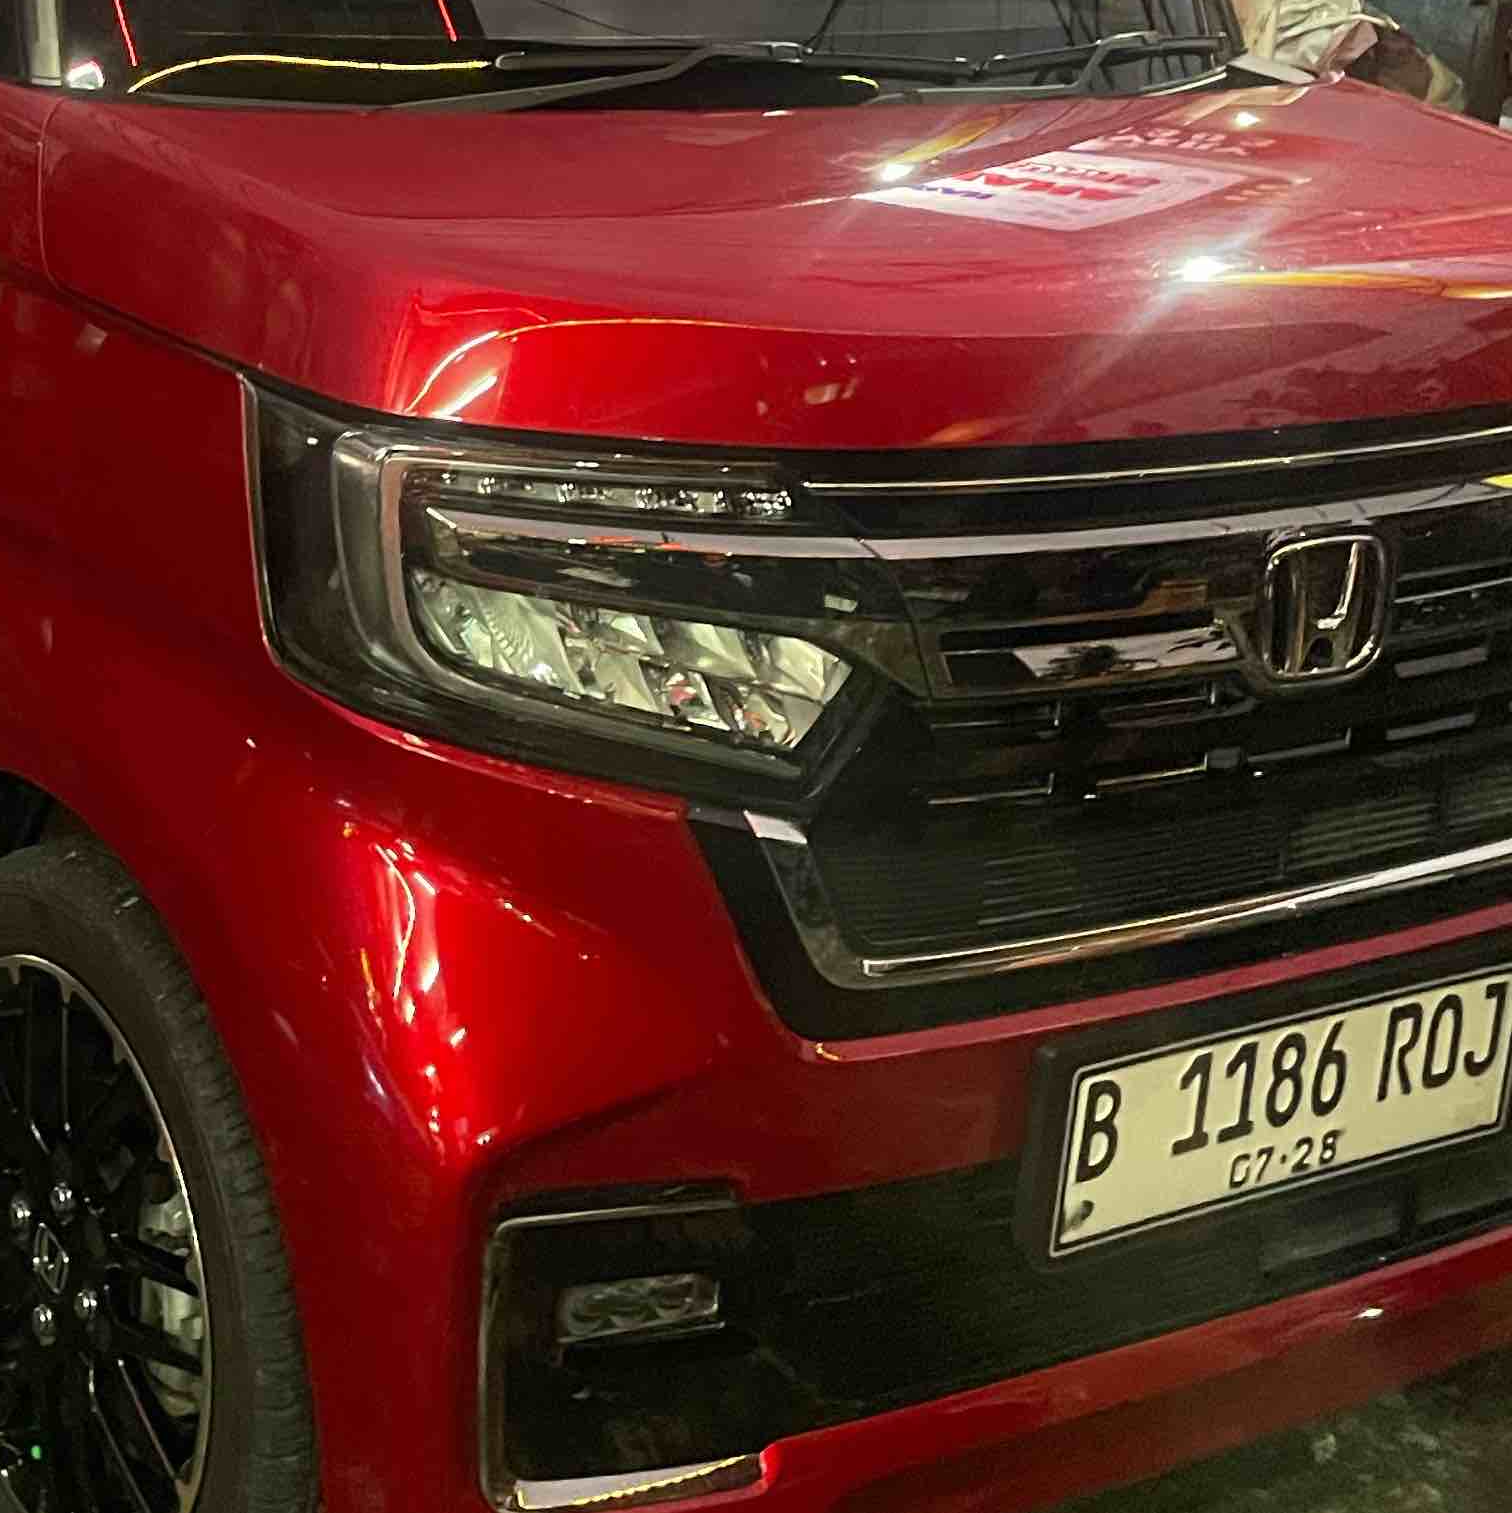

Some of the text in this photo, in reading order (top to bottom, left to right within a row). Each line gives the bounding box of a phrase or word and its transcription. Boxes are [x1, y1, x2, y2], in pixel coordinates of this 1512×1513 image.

[1074, 981, 1510, 1184] B 1186 ROJ
